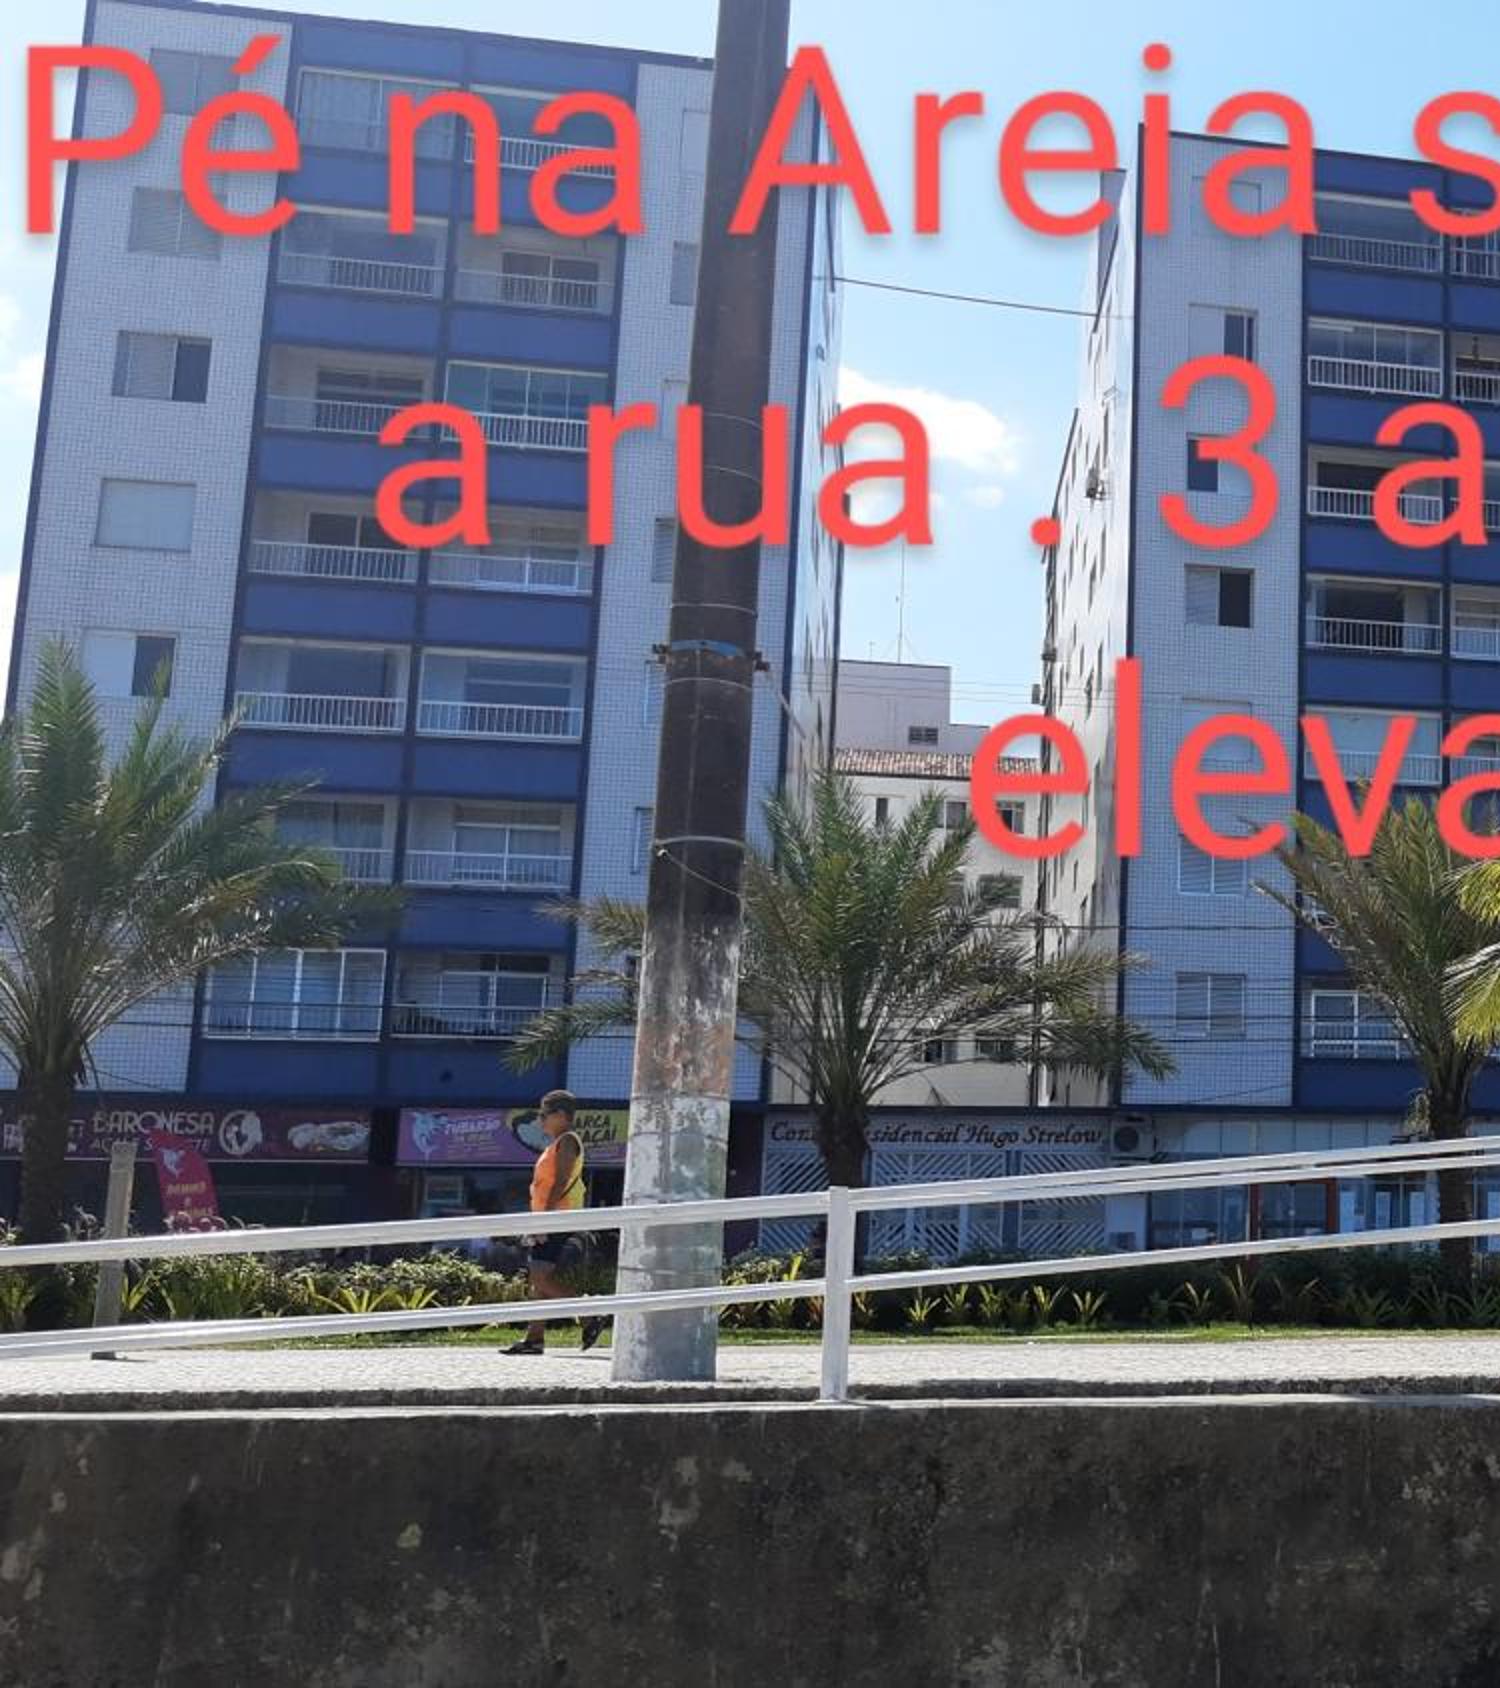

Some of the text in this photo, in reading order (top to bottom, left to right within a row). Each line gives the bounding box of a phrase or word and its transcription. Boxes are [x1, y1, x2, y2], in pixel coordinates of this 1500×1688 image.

[94, 1111, 214, 1135] BARONESA
[575, 1114, 610, 1129] ARCA
[866, 1123, 960, 1143] sidencial
[963, 1123, 1020, 1148] Hugo
[1023, 1124, 1101, 1144] Strelow
